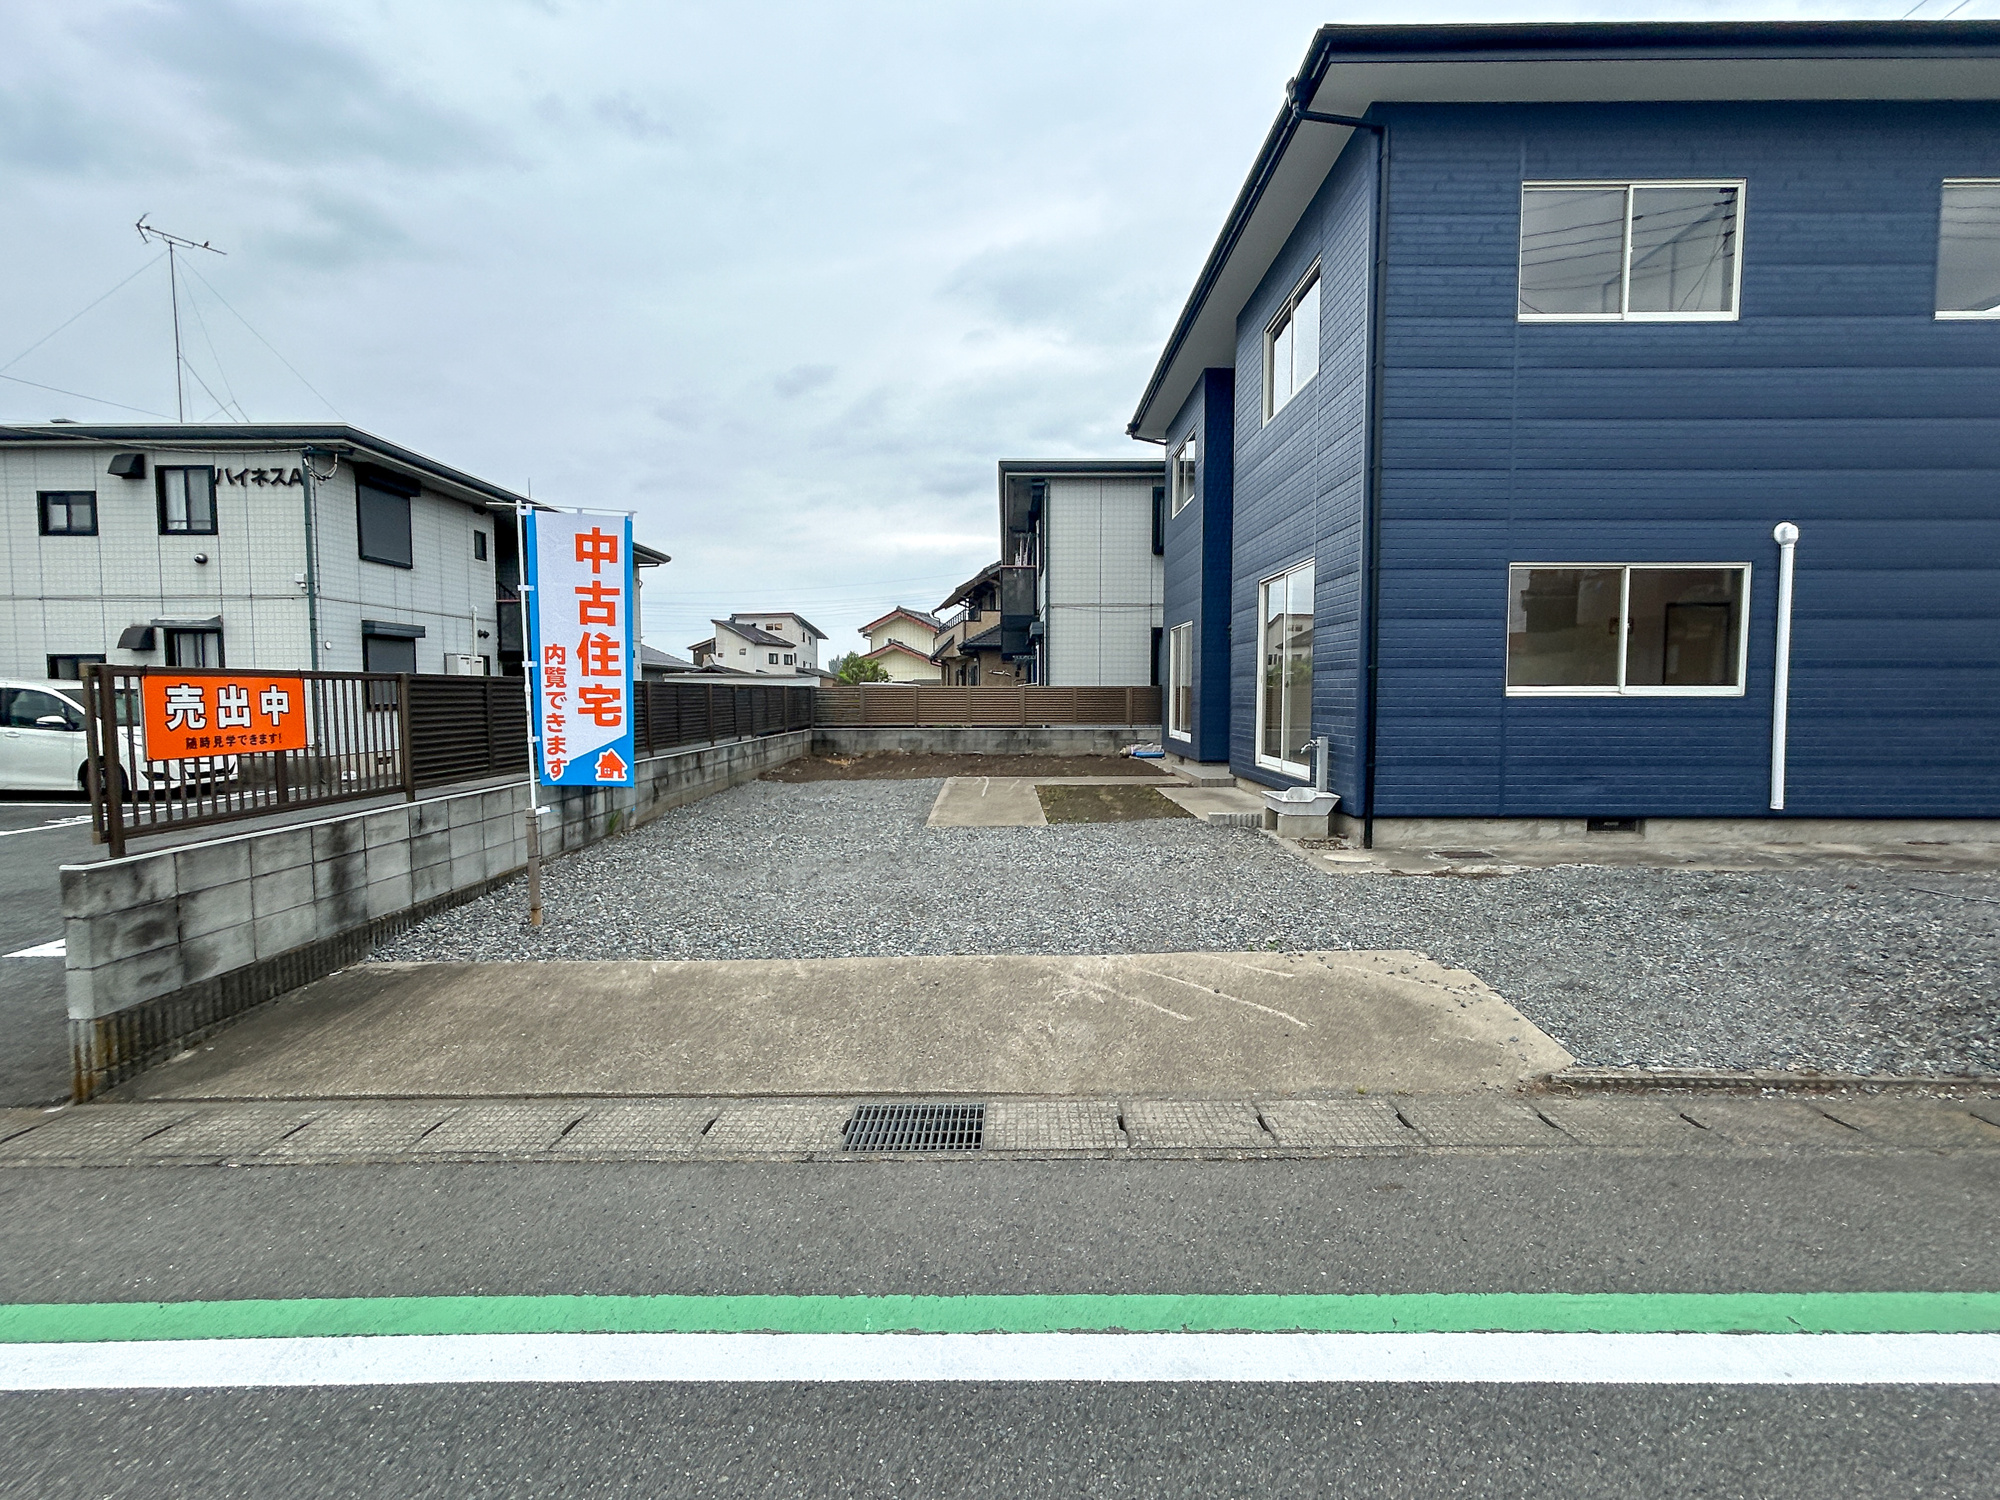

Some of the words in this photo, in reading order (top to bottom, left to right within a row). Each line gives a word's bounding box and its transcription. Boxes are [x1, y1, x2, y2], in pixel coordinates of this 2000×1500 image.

[215, 468, 303, 486] ハイネスA
[575, 527, 622, 727] 中古住宅
[166, 683, 290, 732] 売出中
[544, 643, 568, 778] 内覧できます
